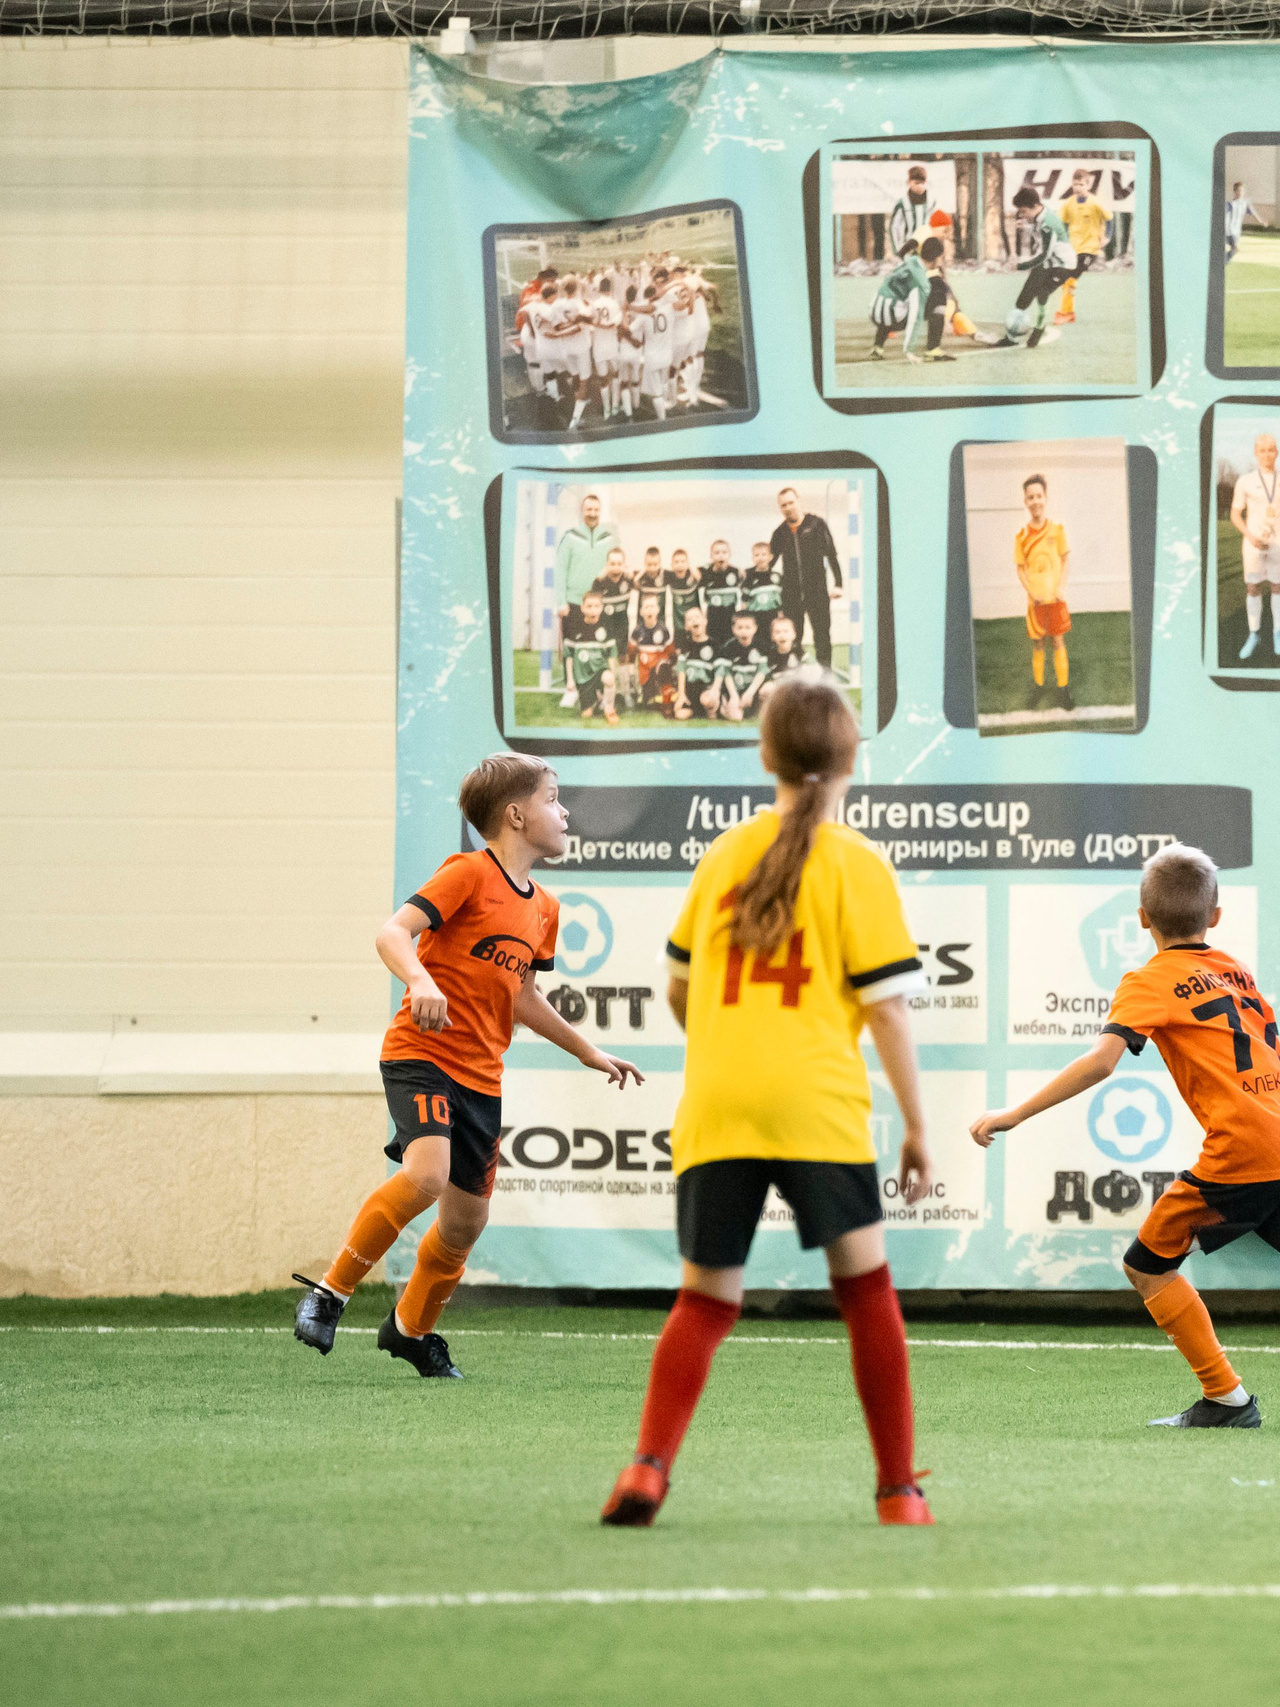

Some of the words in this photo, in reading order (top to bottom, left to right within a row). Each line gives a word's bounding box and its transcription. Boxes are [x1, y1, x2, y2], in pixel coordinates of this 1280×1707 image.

[543, 835, 672, 864] Детские
[878, 839, 988, 864] урниры
[996, 839, 1012, 858] в
[1018, 834, 1076, 864] Туле
[536, 984, 654, 1031] ФТТ
[1013, 1019, 1067, 1035] мебель
[413, 1093, 450, 1126] 10
[539, 1177, 603, 1196] спортивной
[1047, 1170, 1177, 1222] ДФТ
[923, 1203, 979, 1223] работы
